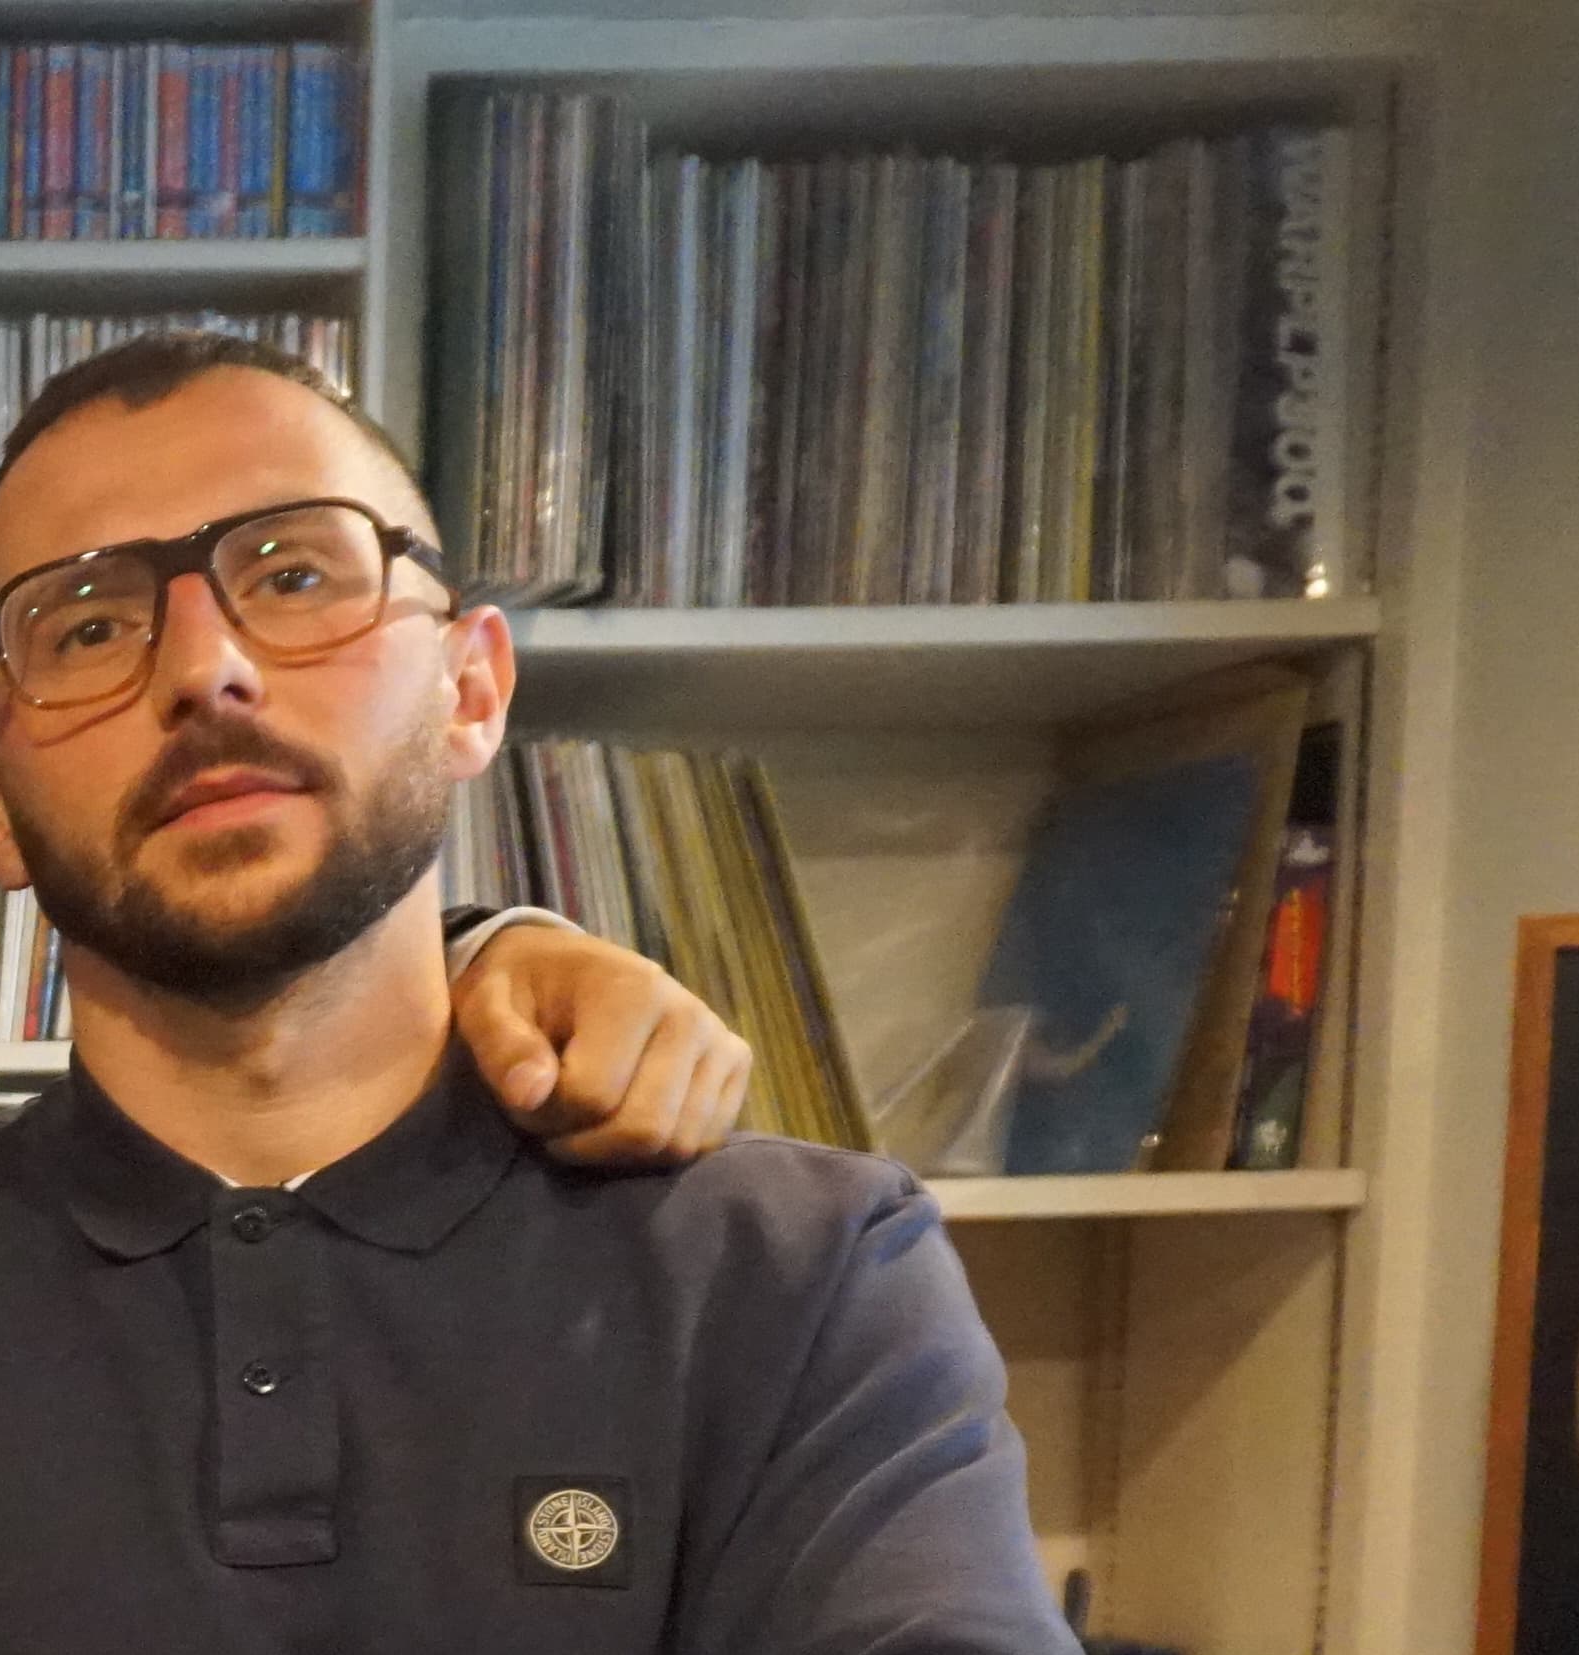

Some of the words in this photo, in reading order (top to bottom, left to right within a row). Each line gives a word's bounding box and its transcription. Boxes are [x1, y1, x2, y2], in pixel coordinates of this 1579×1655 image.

[536, 1496, 570, 1528] STONE
[576, 1496, 613, 1528] ISLAND
[579, 1532, 612, 1563] STONE
